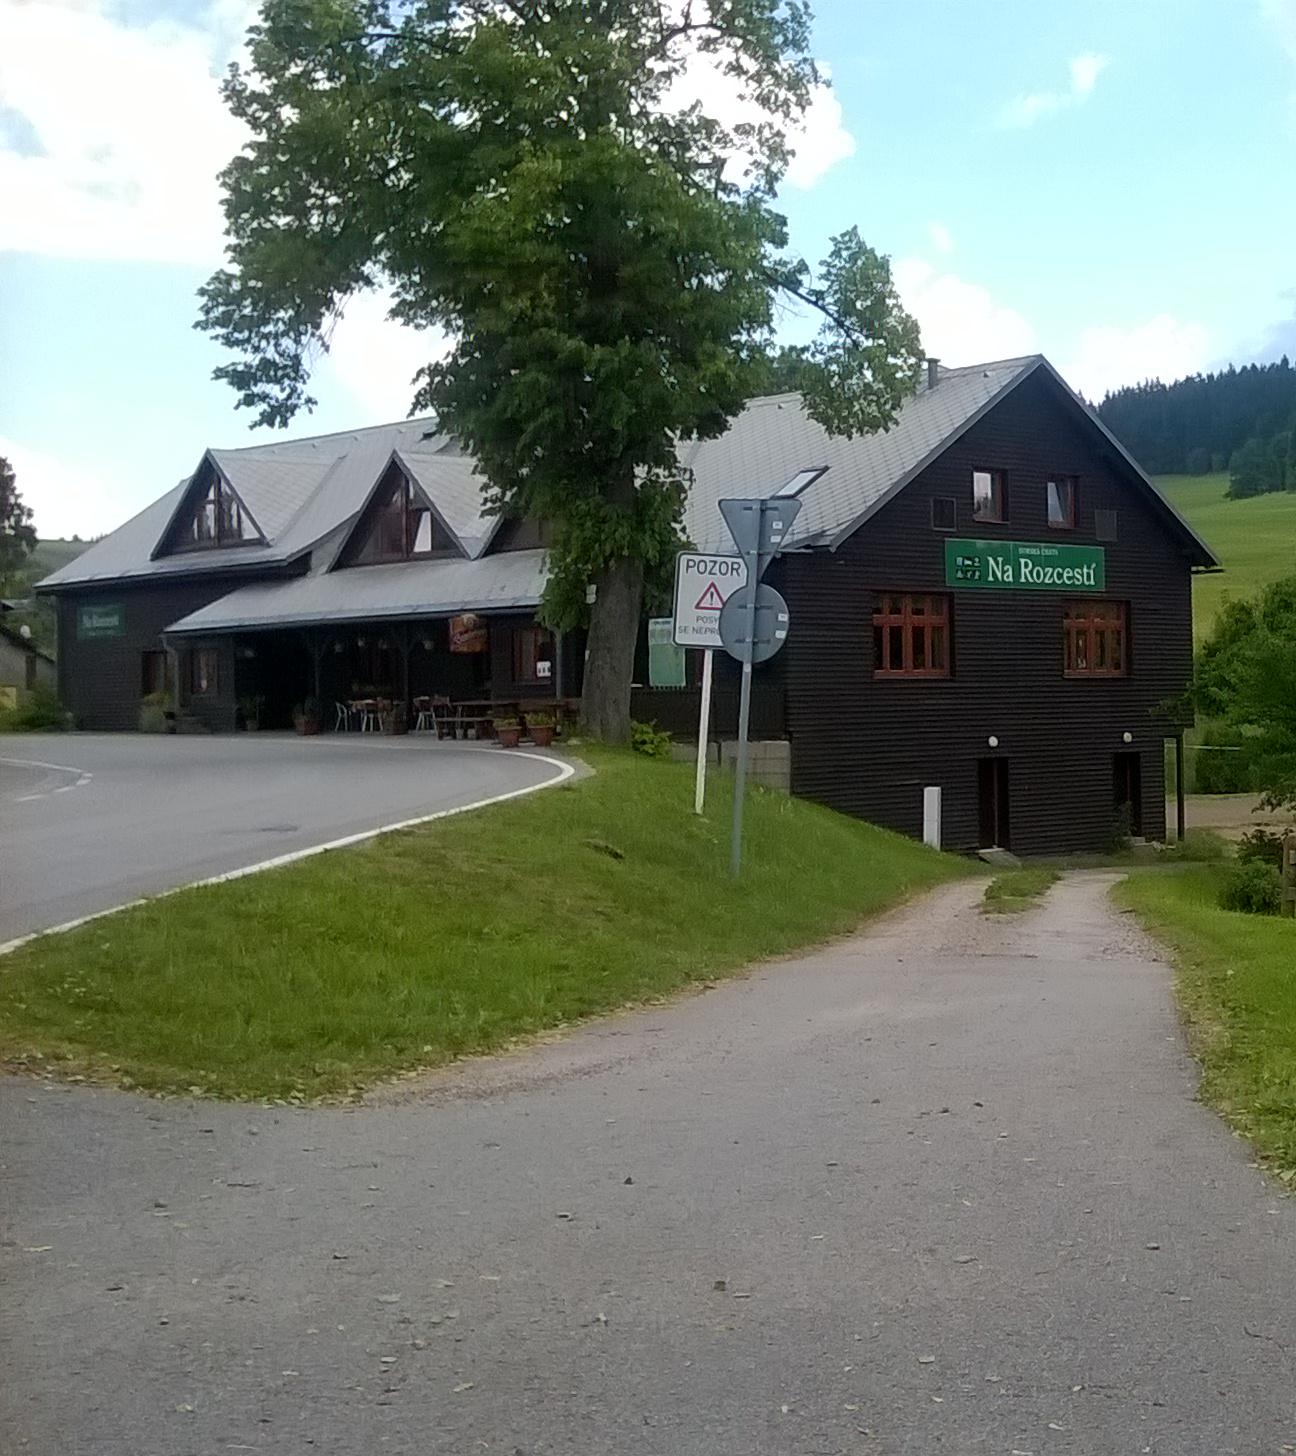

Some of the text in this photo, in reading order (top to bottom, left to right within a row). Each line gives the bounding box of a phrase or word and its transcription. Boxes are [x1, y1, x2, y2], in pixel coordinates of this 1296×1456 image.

[685, 558, 741, 577] POZOR
[987, 557, 1096, 586] Na Rozcestí
[696, 615, 719, 625] POSY
[678, 626, 719, 637] SE NEPR
